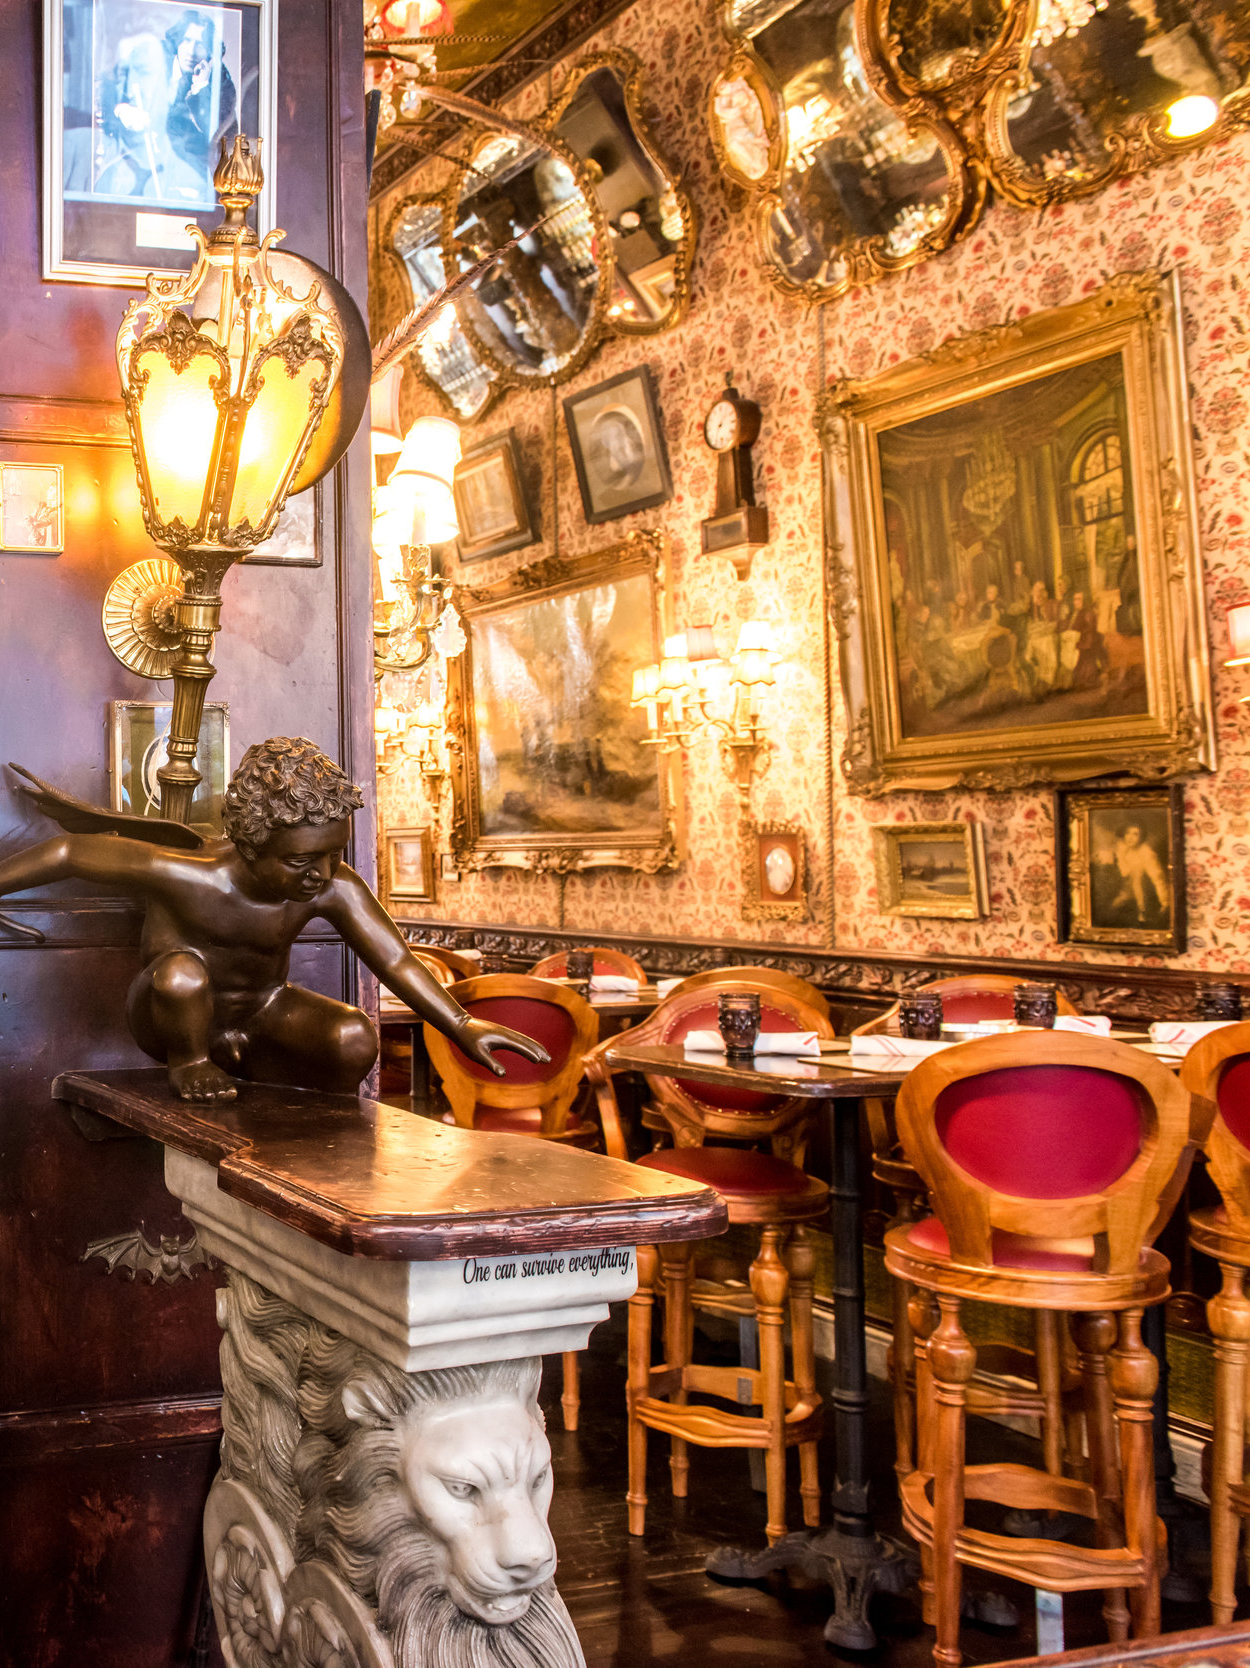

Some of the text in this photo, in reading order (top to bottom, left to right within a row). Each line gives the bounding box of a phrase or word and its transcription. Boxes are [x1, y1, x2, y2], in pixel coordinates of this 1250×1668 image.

[463, 1247, 634, 1284] One can survive everything,
